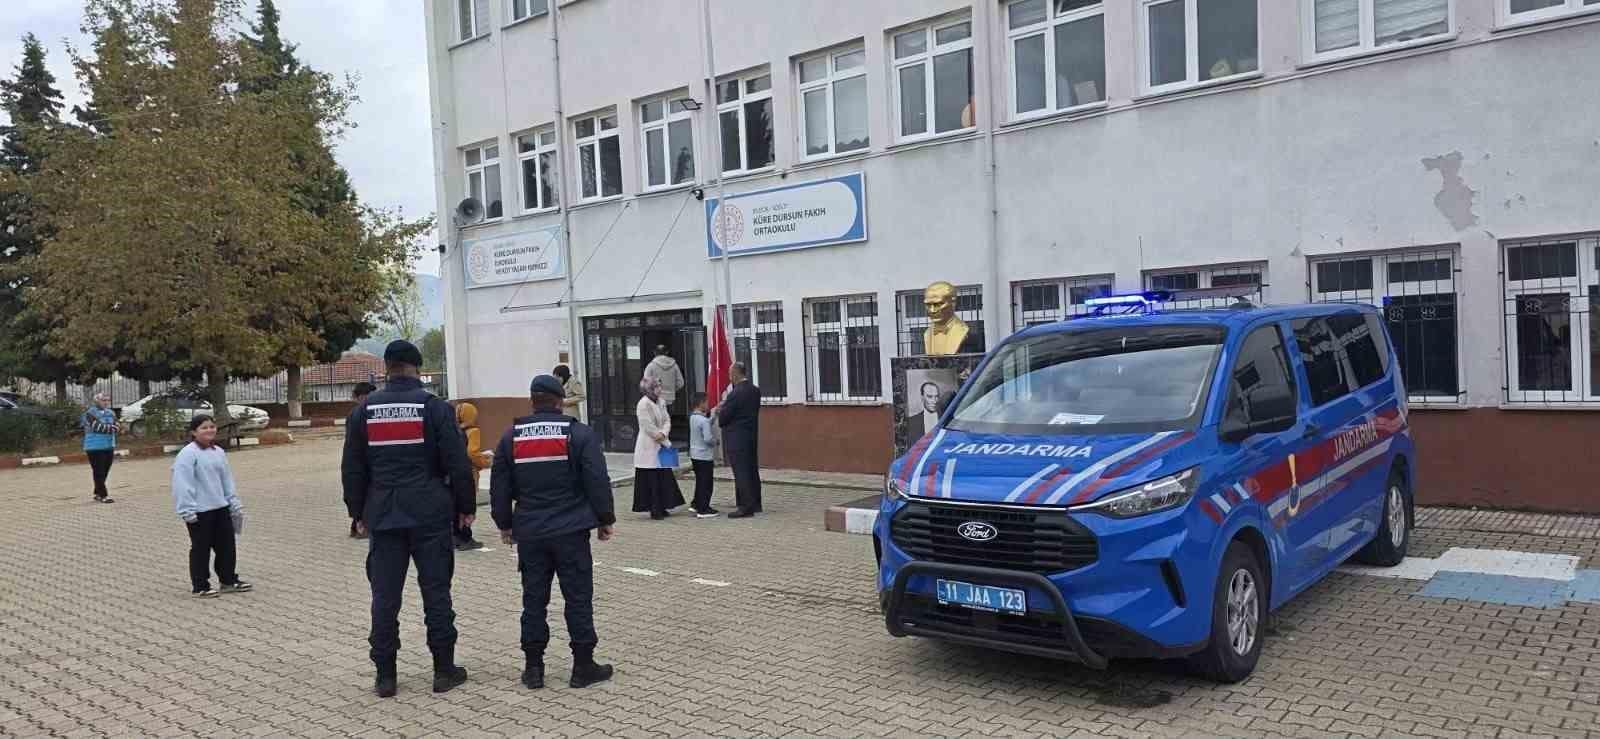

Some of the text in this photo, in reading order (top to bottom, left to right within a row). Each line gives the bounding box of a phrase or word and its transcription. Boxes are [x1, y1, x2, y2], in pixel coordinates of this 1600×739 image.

[773, 210, 803, 223] DURSUN
[753, 222, 796, 236] ORTAOKULU
[372, 406, 418, 419] JANDARMA
[519, 424, 563, 437] JANDARMA
[1333, 420, 1378, 460] JANDARMA
[943, 442, 1093, 458] JANDARMA
[963, 523, 990, 538] Ford
[945, 583, 957, 600] 11
[966, 583, 991, 605] JAA
[999, 590, 1023, 610] 123
